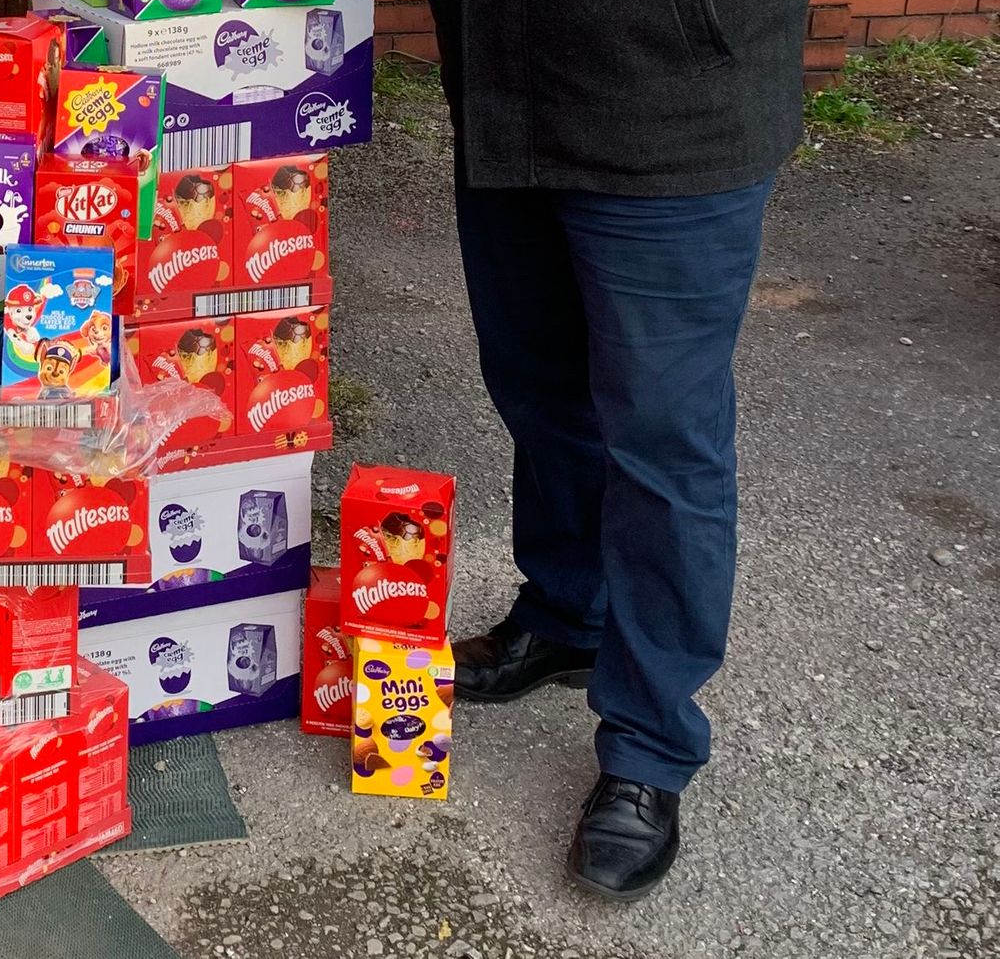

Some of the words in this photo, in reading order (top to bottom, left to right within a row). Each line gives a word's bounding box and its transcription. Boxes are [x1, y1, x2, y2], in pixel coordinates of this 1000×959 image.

[147, 29, 153, 37] 9
[216, 29, 249, 46] Cadbury
[236, 37, 270, 57] creme
[242, 50, 267, 68] egg
[75, 89, 113, 122] creme
[88, 101, 115, 125] egg
[299, 102, 326, 117] Cadbury
[316, 108, 345, 125] creme
[320, 119, 342, 133] egg
[59, 185, 114, 220] KitKat
[246, 191, 278, 222] Maltesers
[65, 224, 104, 235] CHUNKY
[149, 244, 219, 293] Maltesers
[245, 235, 314, 283] Maltesers
[248, 343, 277, 373] Maltesers
[248, 383, 314, 433] Maltesers
[174, 512, 195, 525] creme
[177, 521, 193, 530] egg
[46, 505, 130, 555] Maltesers
[354, 528, 386, 561] Maltesers
[352, 578, 427, 614] Maltesers
[316, 628, 347, 660] Maltesers
[364, 665, 389, 675] Cadbury
[381, 677, 424, 697] Mini
[381, 694, 429, 712] eggs
[29, 730, 58, 760] Maltesers
